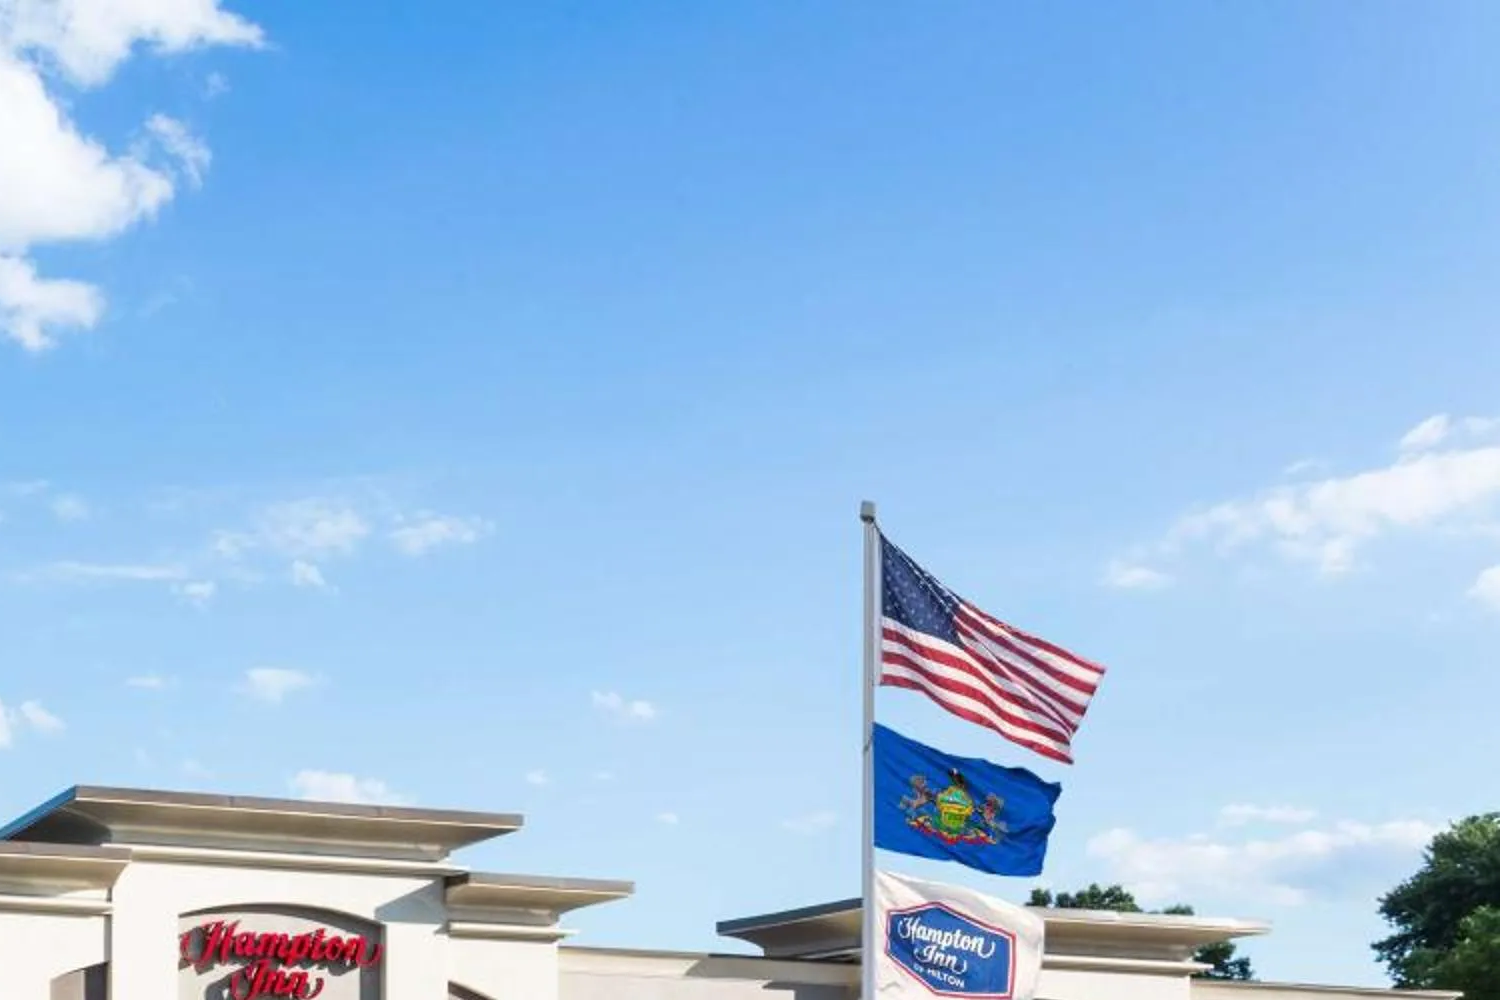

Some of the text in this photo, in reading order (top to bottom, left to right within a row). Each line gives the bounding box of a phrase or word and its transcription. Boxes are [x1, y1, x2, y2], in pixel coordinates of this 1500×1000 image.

[179, 919, 383, 968] Hampton
[898, 916, 995, 959] Hampton
[913, 945, 967, 975] Inn
